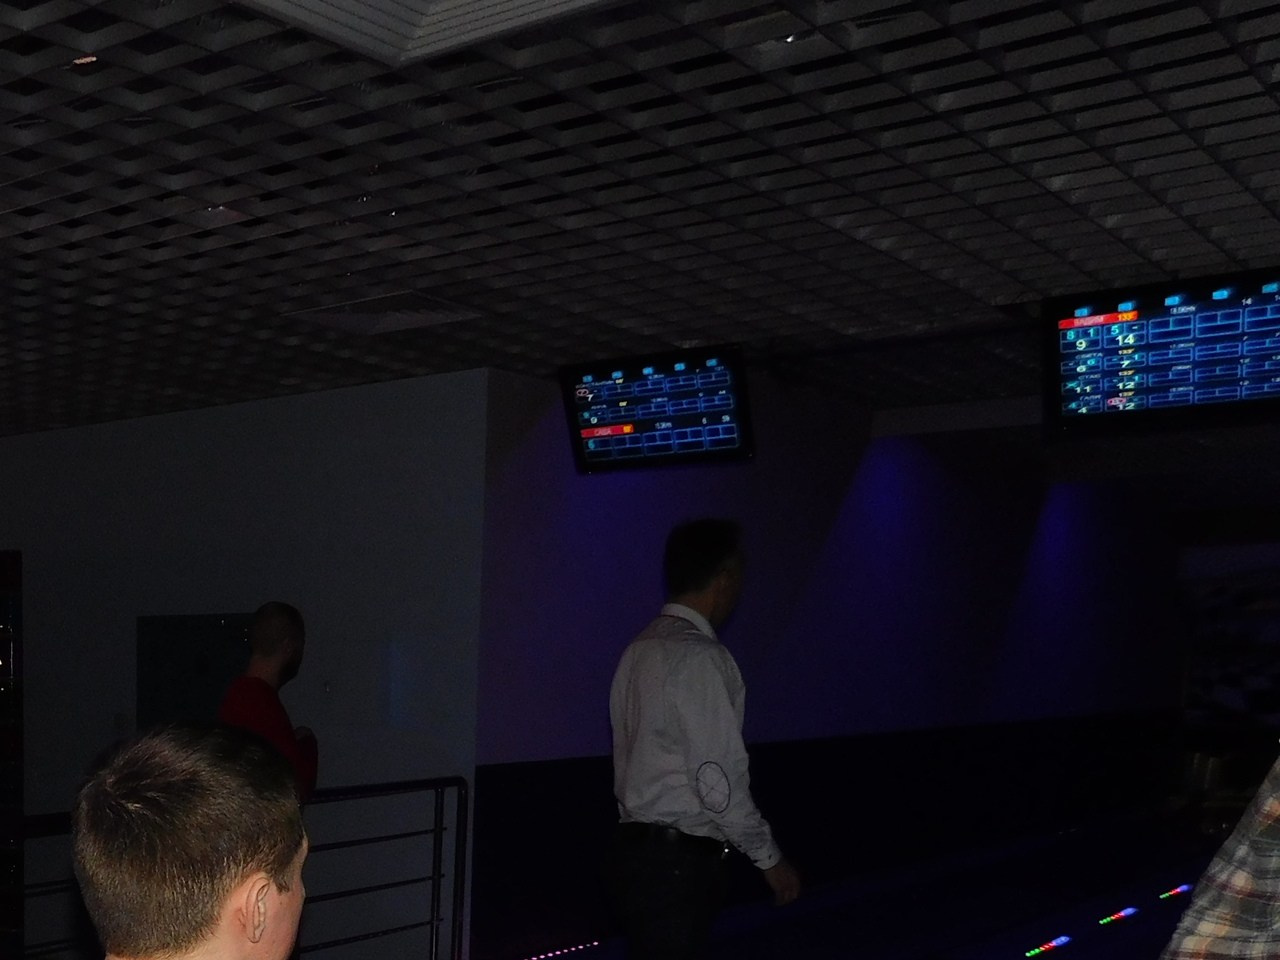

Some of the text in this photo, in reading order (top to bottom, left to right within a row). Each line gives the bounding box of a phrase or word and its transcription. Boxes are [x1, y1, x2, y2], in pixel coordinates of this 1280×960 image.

[1067, 331, 1075, 340] 8
[1111, 325, 1119, 335] 5
[1076, 334, 1134, 350] 9 14
[1117, 381, 1135, 389] 12
[1118, 403, 1135, 411] 12
